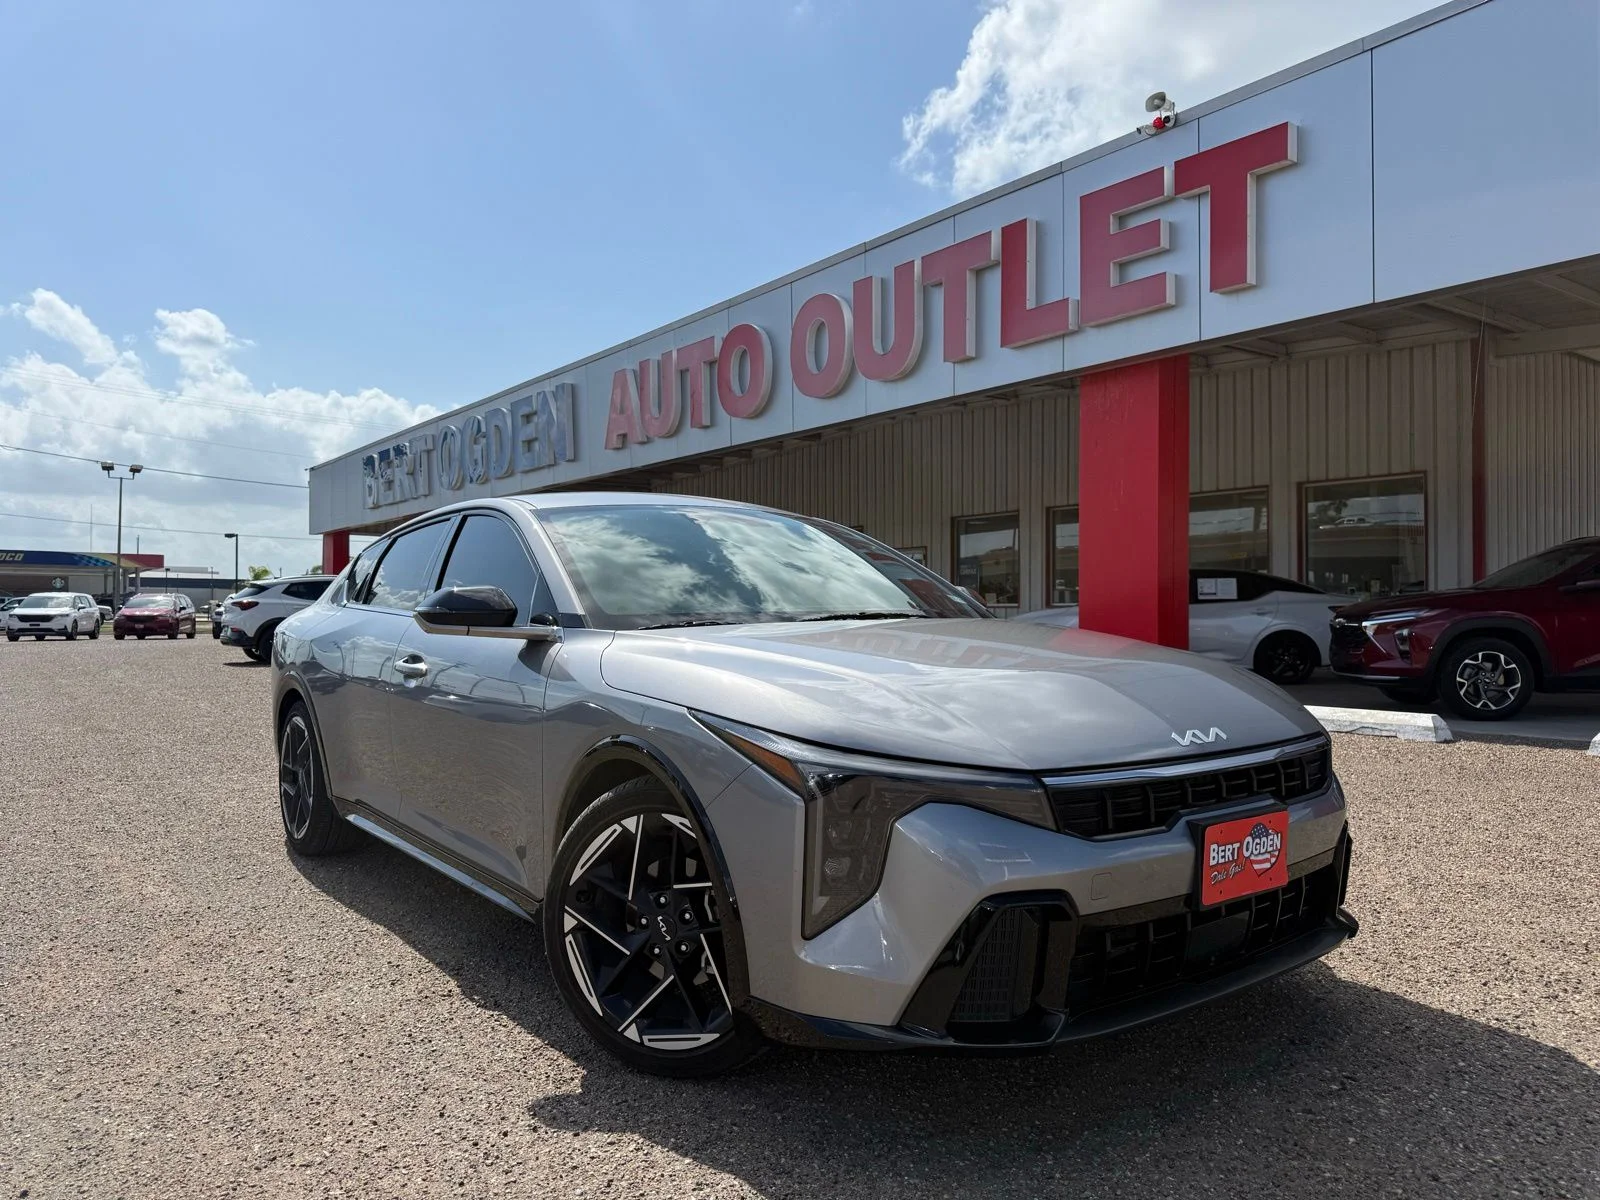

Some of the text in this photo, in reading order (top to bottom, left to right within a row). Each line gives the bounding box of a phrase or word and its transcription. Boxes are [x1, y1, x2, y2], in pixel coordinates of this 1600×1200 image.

[362, 121, 1299, 509] BERT OGDEN AUTO OUTLET
[1209, 832, 1281, 866] BERT OGDEN
